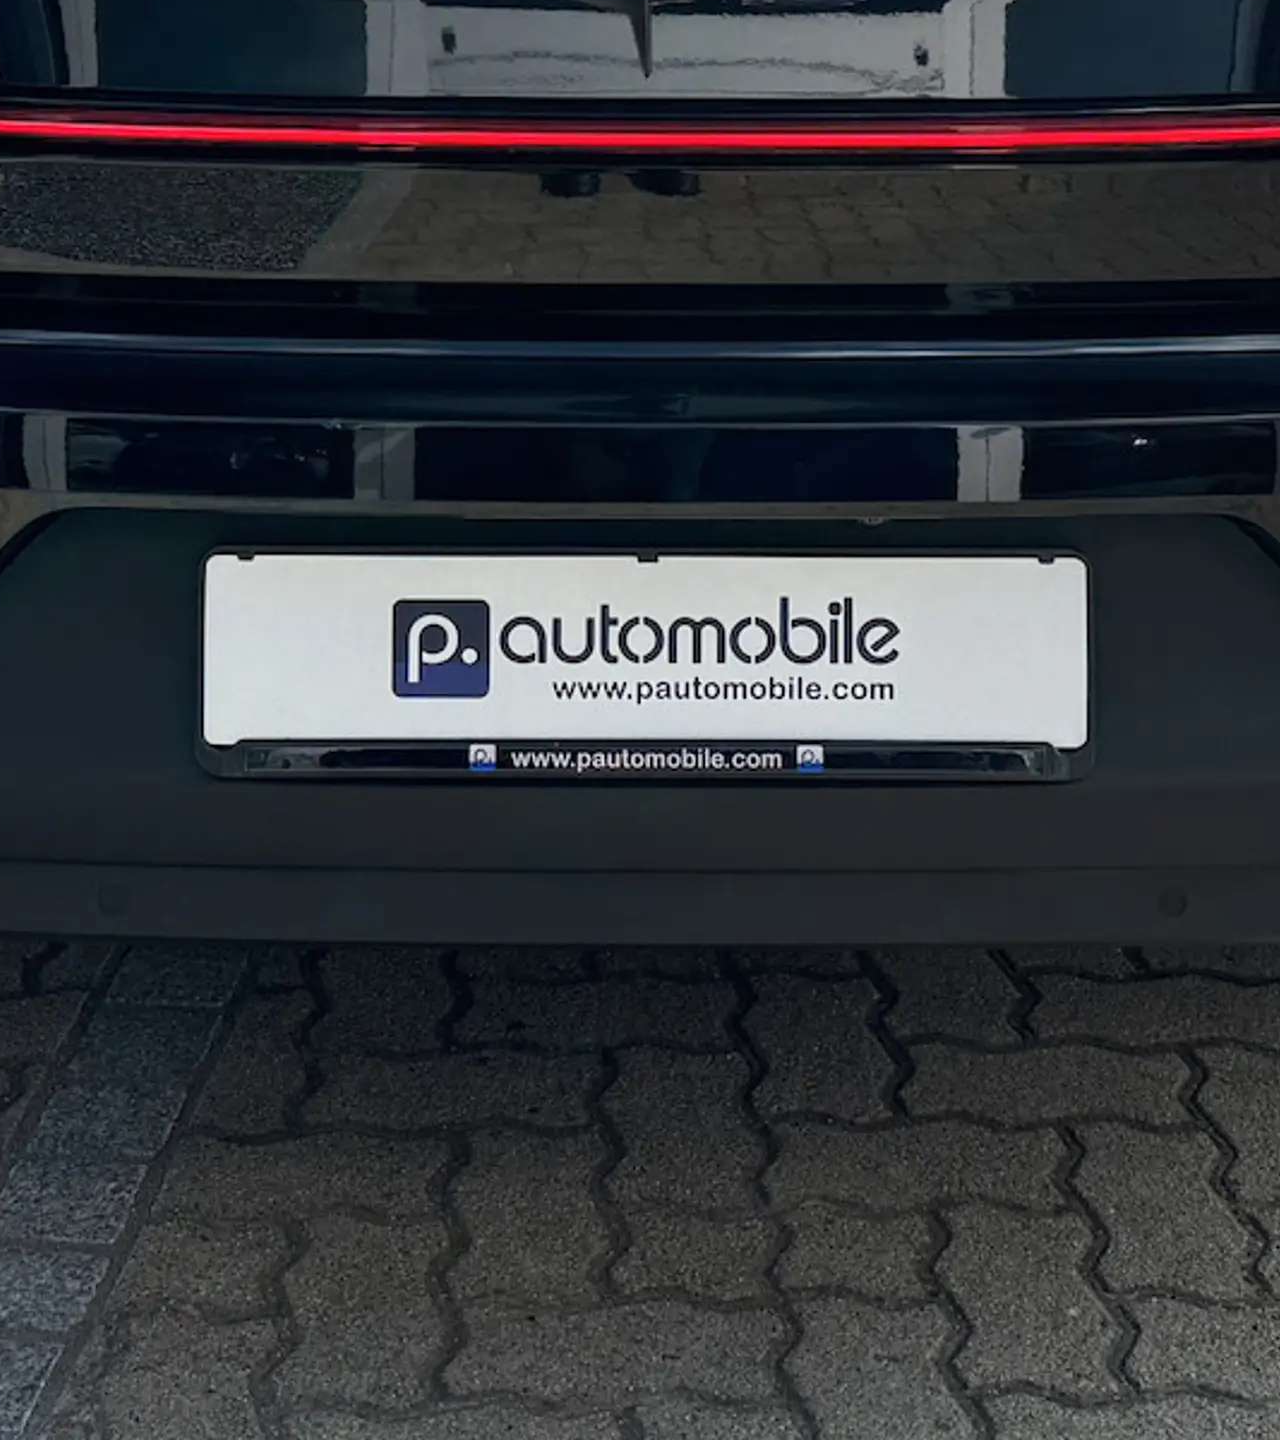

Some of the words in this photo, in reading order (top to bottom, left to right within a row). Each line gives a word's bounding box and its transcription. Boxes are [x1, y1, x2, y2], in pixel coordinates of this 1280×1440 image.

[499, 597, 901, 666] automobile
[553, 676, 895, 703] www.pautomobile.com
[511, 748, 782, 773] www.pautomobile.com
